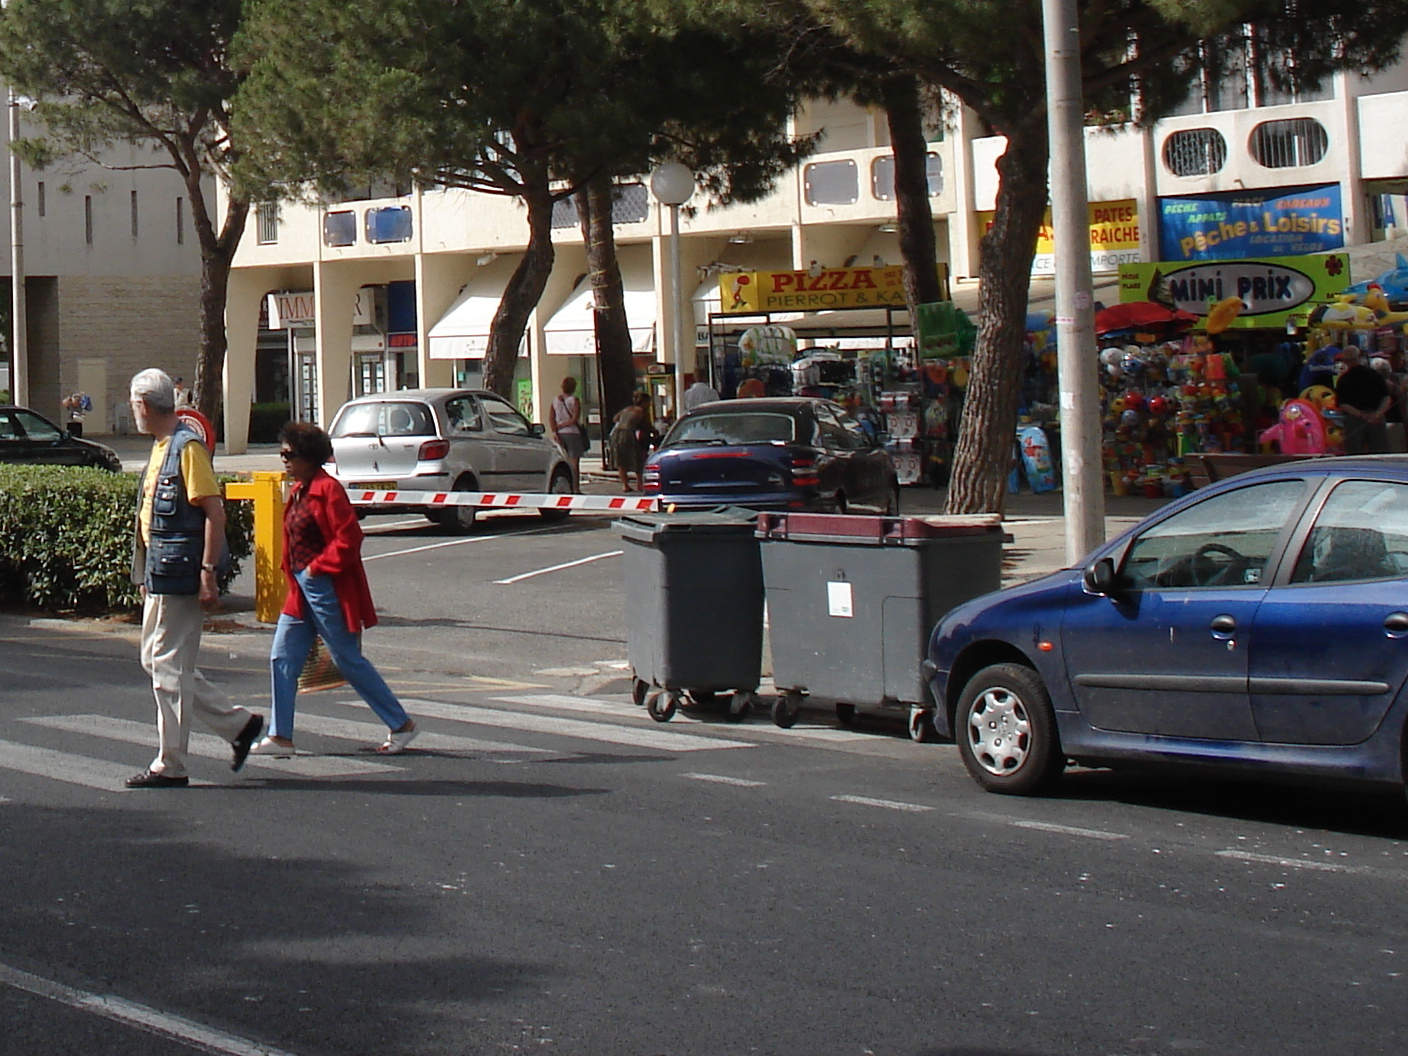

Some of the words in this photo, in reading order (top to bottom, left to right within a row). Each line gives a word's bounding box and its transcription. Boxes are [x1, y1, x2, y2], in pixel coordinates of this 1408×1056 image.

[1094, 206, 1133, 224] PATES
[1090, 226, 1140, 244] RAICHE
[1180, 220, 1248, 258] Pêche
[1249, 221, 1260, 233] &
[1262, 211, 1342, 236] Loisirs
[1090, 252, 1140, 266] MPORTE
[771, 270, 878, 293] PIZZA
[767, 291, 847, 307] PIERROT
[855, 291, 869, 304] &
[876, 290, 906, 303] KA
